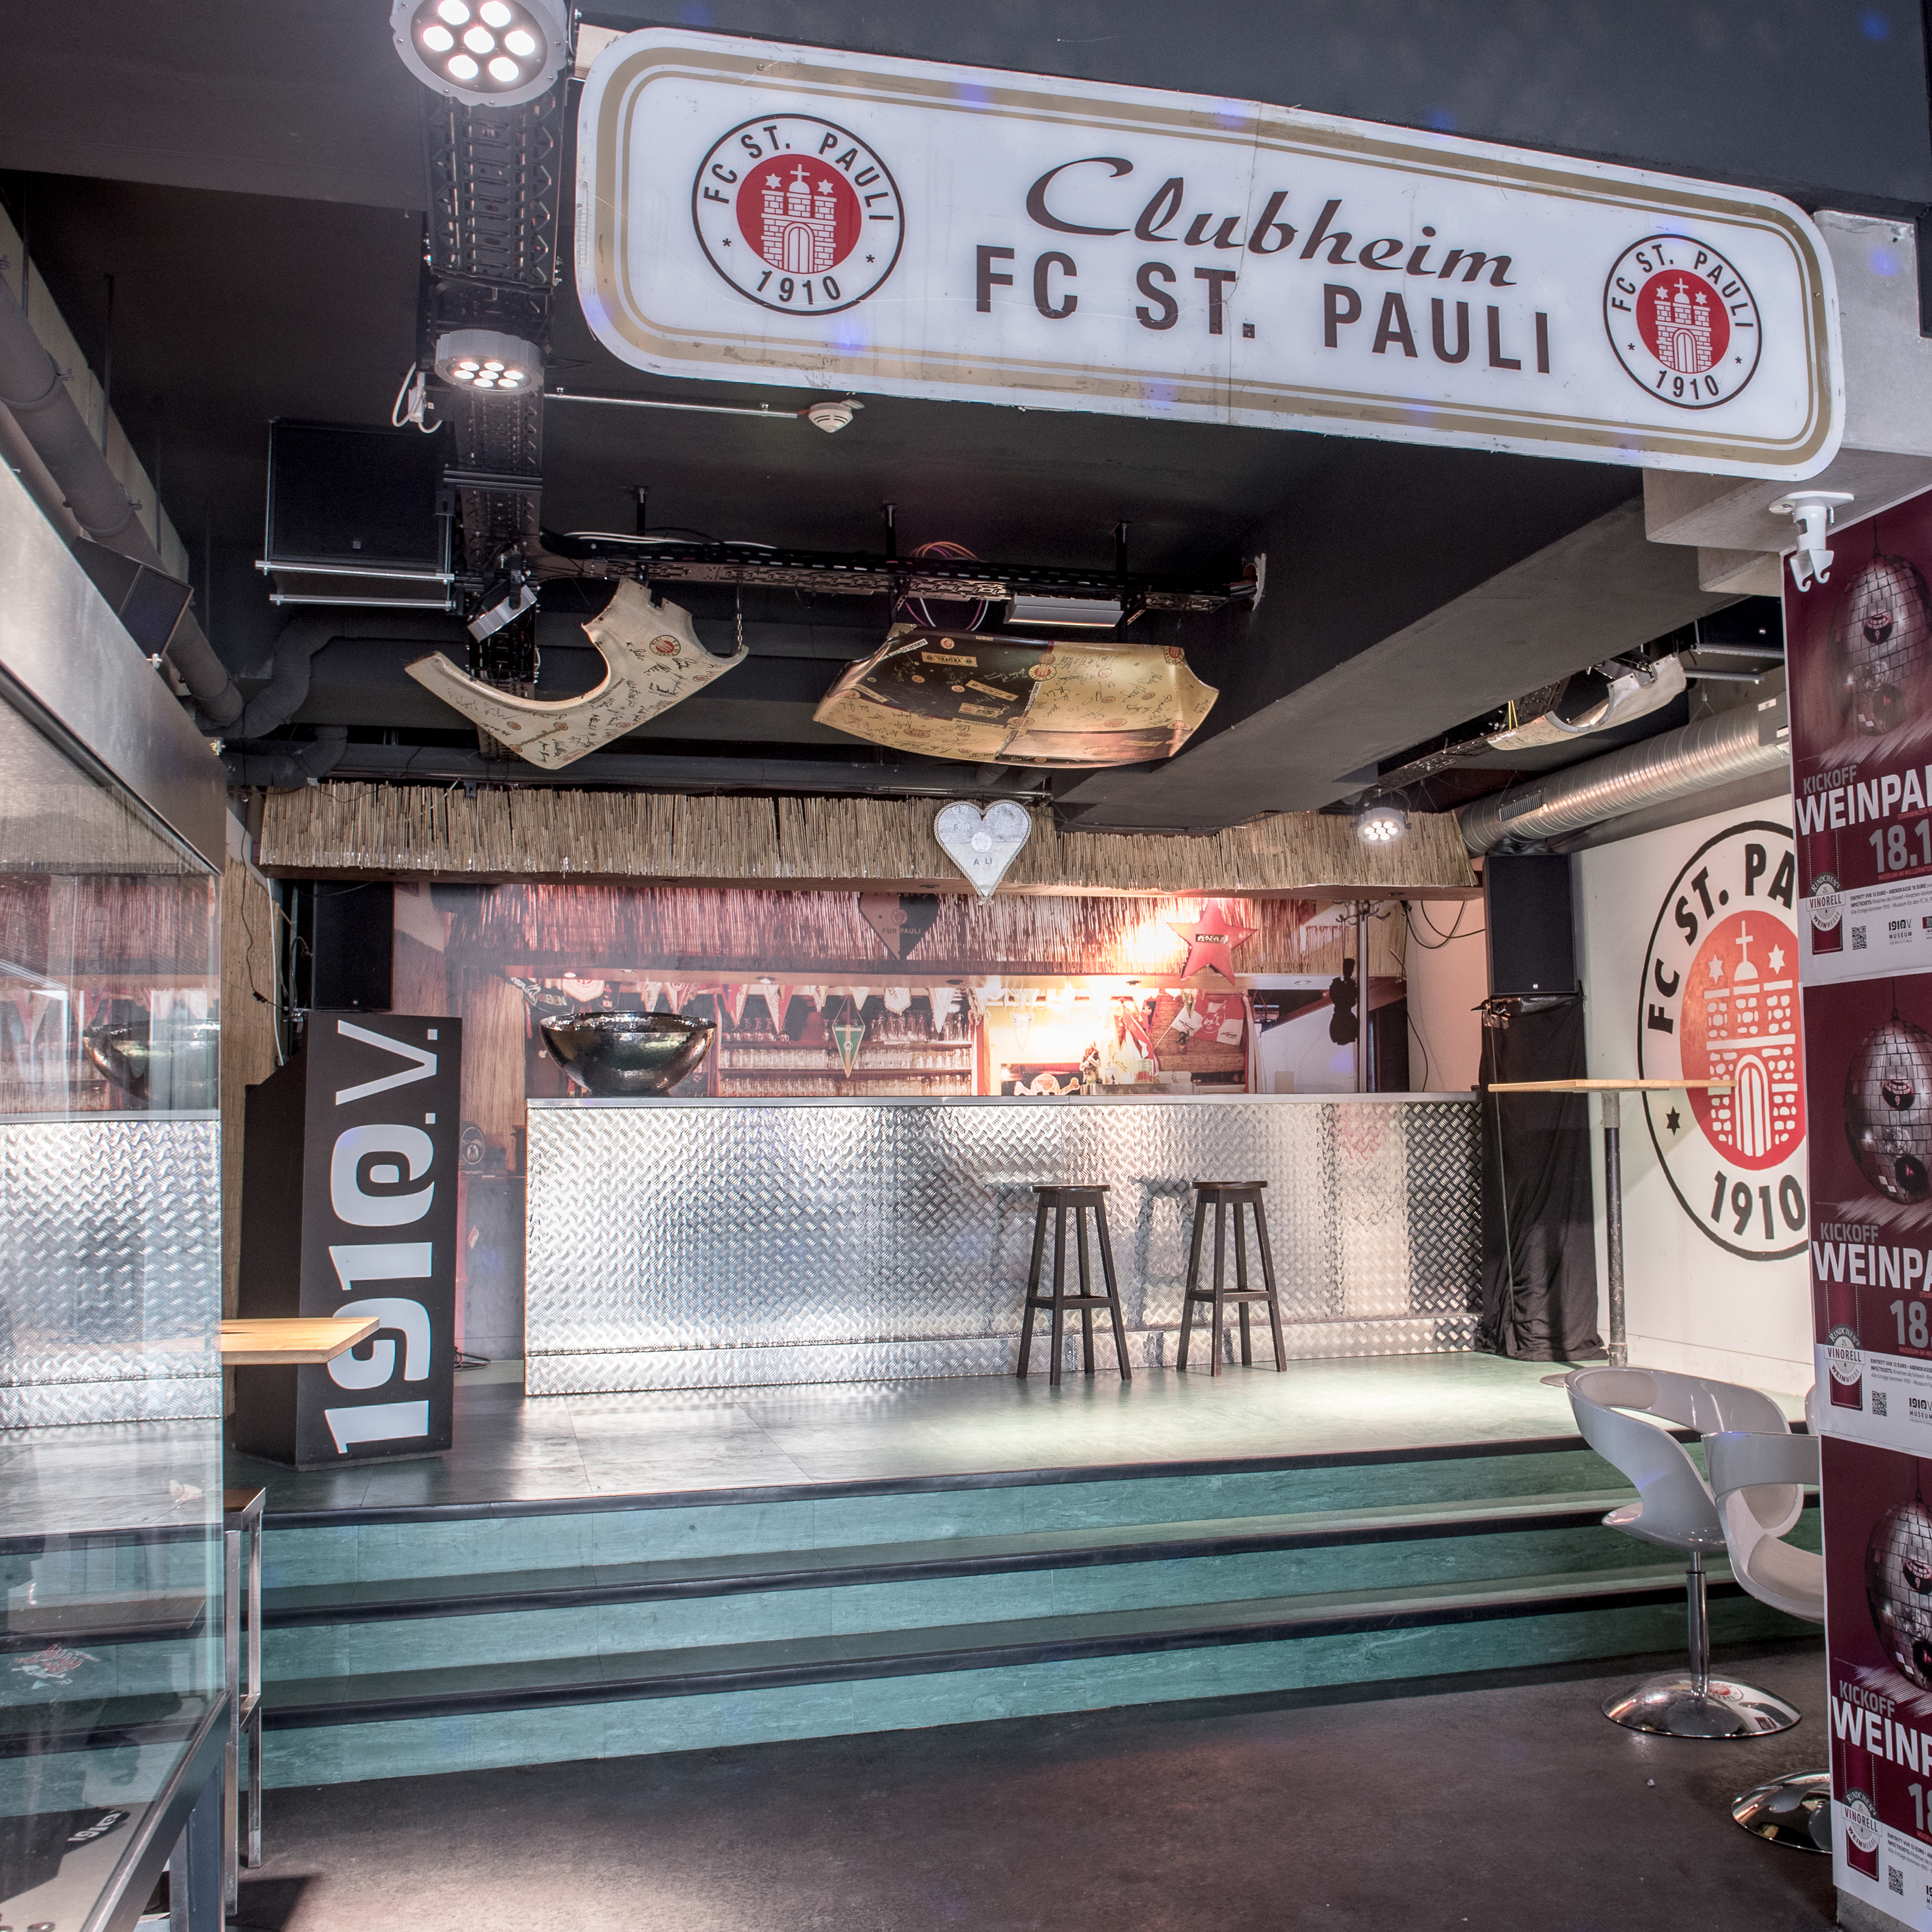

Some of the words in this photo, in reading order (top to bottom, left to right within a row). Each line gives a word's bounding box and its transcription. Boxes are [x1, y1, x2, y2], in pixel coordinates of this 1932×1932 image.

[704, 164, 738, 204] FC
[741, 125, 791, 159] ST.
[819, 132, 894, 220] PAULI
[1026, 156, 1517, 287] Clubheim
[757, 270, 841, 305] 1910
[1611, 276, 1636, 312] FC
[1635, 244, 1674, 273] ST.
[1694, 250, 1754, 328] PAULI
[976, 245, 1078, 320] FC
[1135, 262, 1256, 340] ST.
[1323, 283, 1551, 375] PAULI
[1656, 370, 1719, 401] 1910
[1803, 764, 1857, 795] KICKOFF
[1809, 894, 1842, 909] VINORELL
[1888, 885, 1911, 895] ABENDKASSE
[1813, 911, 1841, 929] WEINMESSE
[1889, 931, 1912, 939] MUSEUM
[1647, 958, 1680, 1036] FC
[1675, 865, 1730, 947] ST.
[1711, 1170, 1806, 1241] 1910
[1820, 1222, 1878, 1243] KICKOFF
[1827, 1347, 1861, 1363] VINORELL
[1831, 1365, 1859, 1383] WEINMESSE
[1839, 1680, 1895, 1718] KICKOFF
[1844, 1806, 1878, 1833] VINORELL
[1848, 1825, 1876, 1850] WEINMESSE
[1915, 1846, 1924, 1855] EURO
